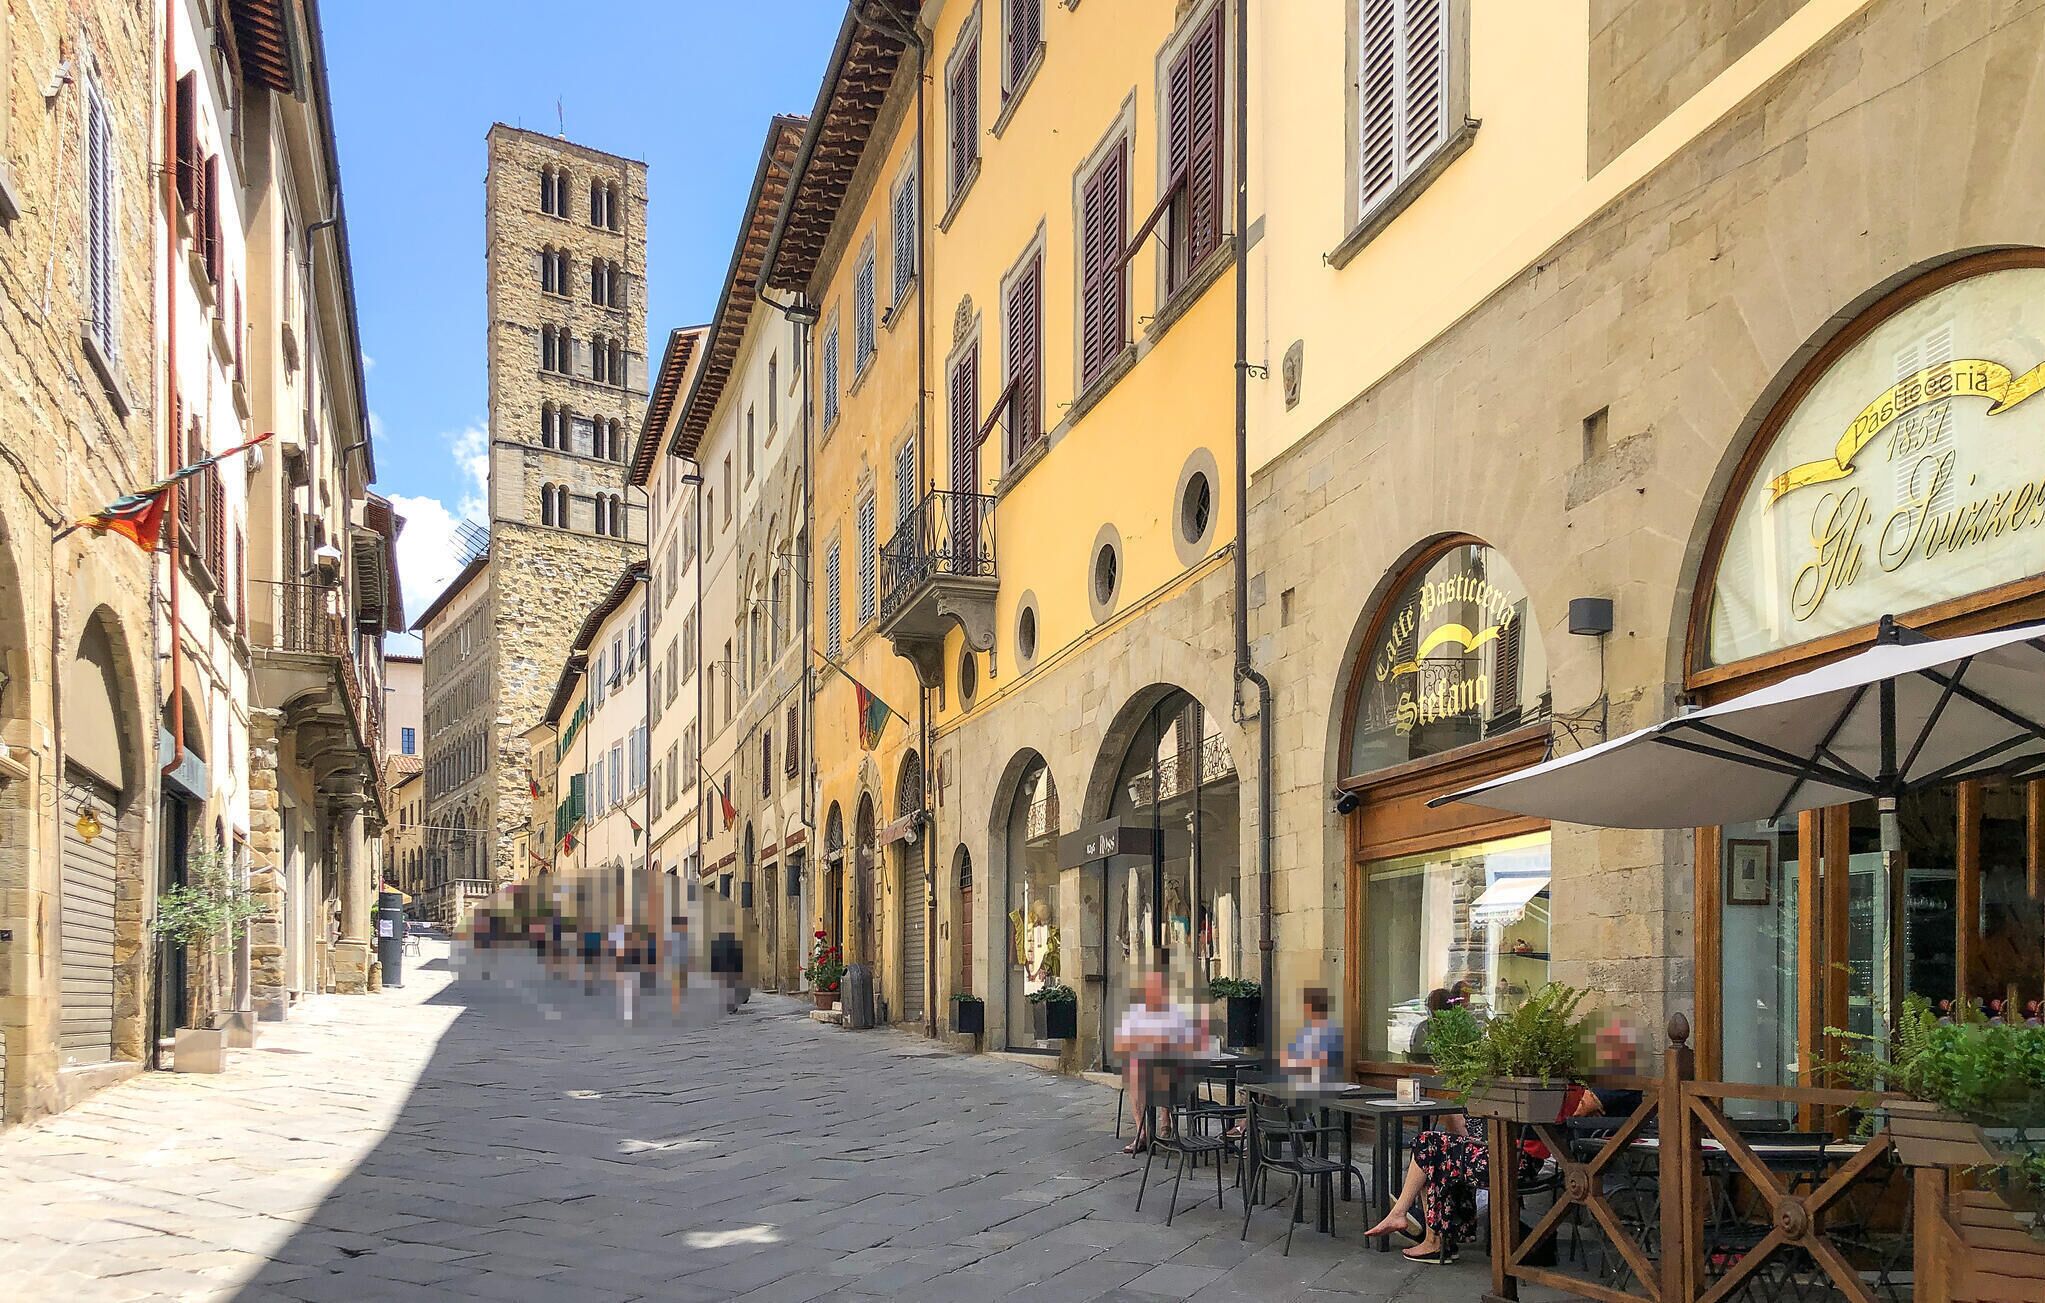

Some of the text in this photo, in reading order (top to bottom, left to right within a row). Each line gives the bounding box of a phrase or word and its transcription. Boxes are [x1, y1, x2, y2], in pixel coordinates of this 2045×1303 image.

[1854, 366, 1988, 449] Pasticceria
[1887, 402, 1950, 462] 1857
[1792, 486, 1872, 622] Gli
[1419, 569, 1515, 631] Pasticceria
[1395, 674, 1487, 736] Stefano
